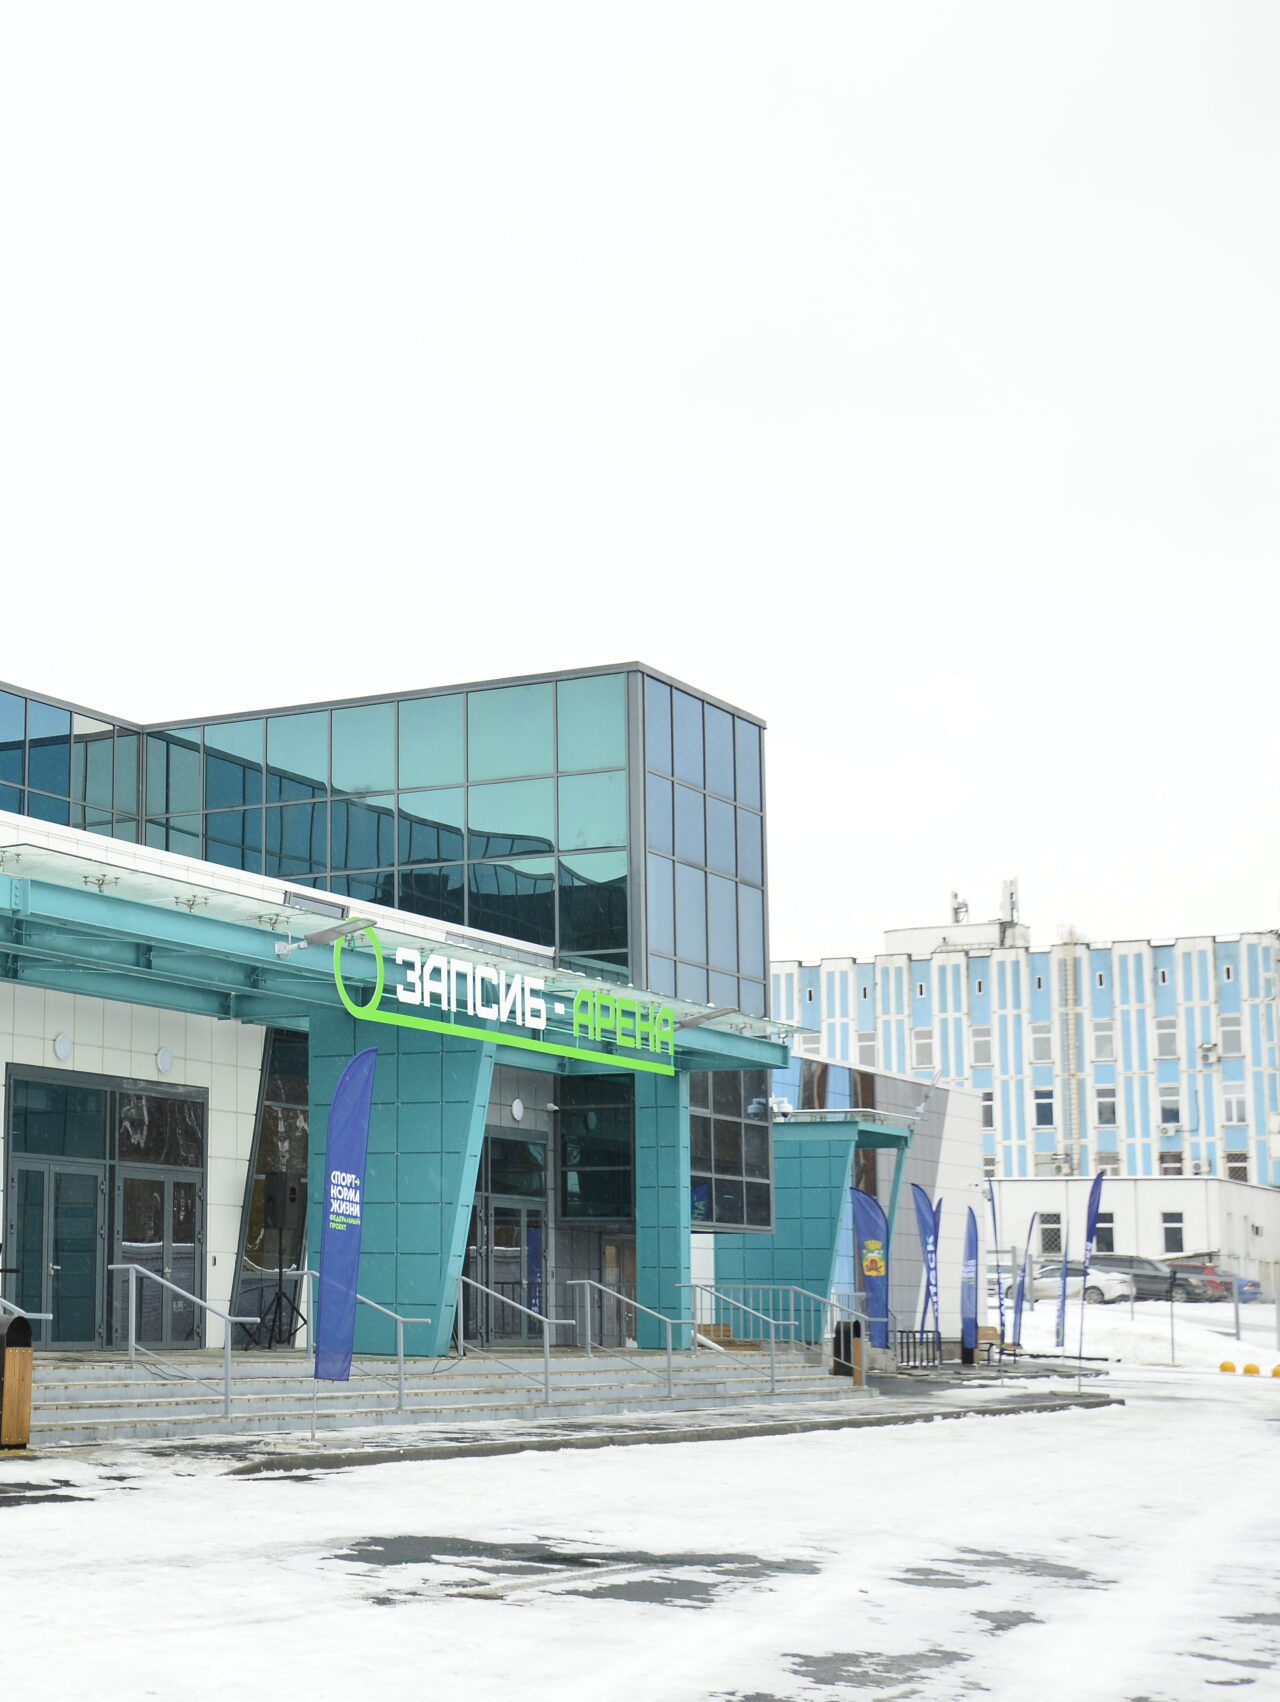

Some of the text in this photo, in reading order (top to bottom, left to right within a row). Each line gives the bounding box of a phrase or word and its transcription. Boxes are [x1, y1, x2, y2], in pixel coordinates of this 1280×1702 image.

[395, 946, 547, 1030] ЗАПСИБ
[573, 988, 675, 1056] АРЕНА
[330, 1184, 360, 1203] НОРМА
[330, 1198, 360, 1217] ЖИЗНИ
